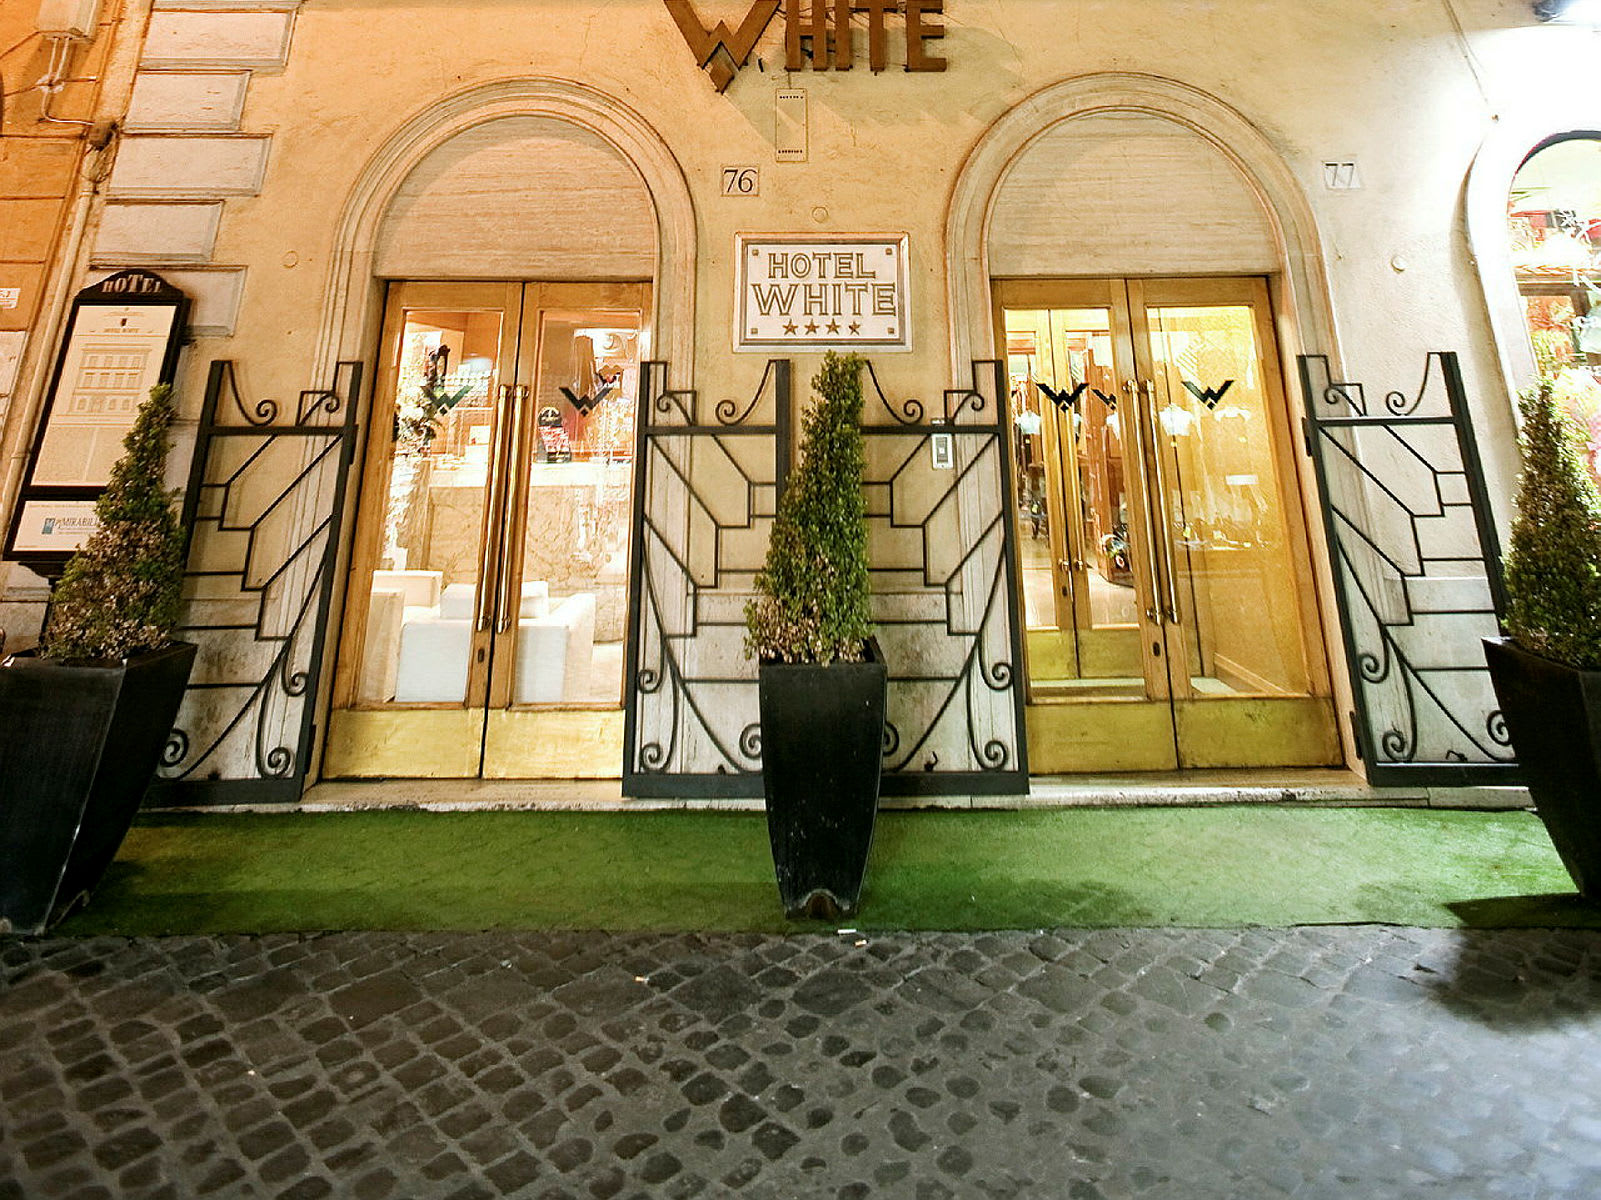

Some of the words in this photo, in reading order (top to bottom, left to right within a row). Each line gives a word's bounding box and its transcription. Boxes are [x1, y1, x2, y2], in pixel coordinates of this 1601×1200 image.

[724, 169, 757, 193] 76
[1325, 163, 1355, 187] 77
[768, 252, 876, 279] HOTEL
[102, 274, 162, 293] HOTEL
[751, 282, 896, 317] WHITE
